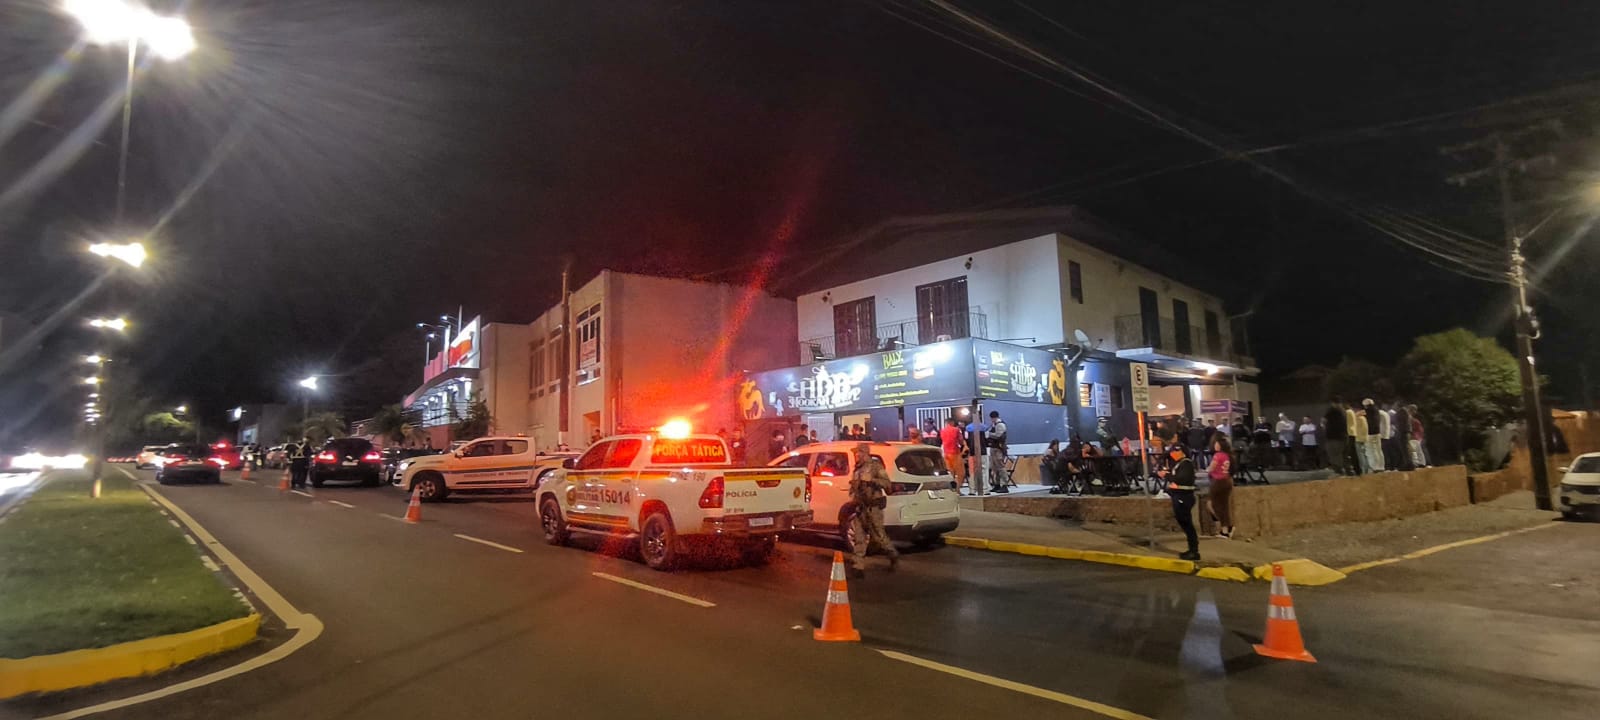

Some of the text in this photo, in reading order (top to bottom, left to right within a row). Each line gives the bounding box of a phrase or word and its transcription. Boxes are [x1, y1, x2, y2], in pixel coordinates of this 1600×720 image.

[1136, 369, 1141, 381] E
[655, 442, 724, 458] FORÇA TÁTICA
[600, 489, 631, 504] 15014
[726, 490, 757, 498] POLÍCIA
